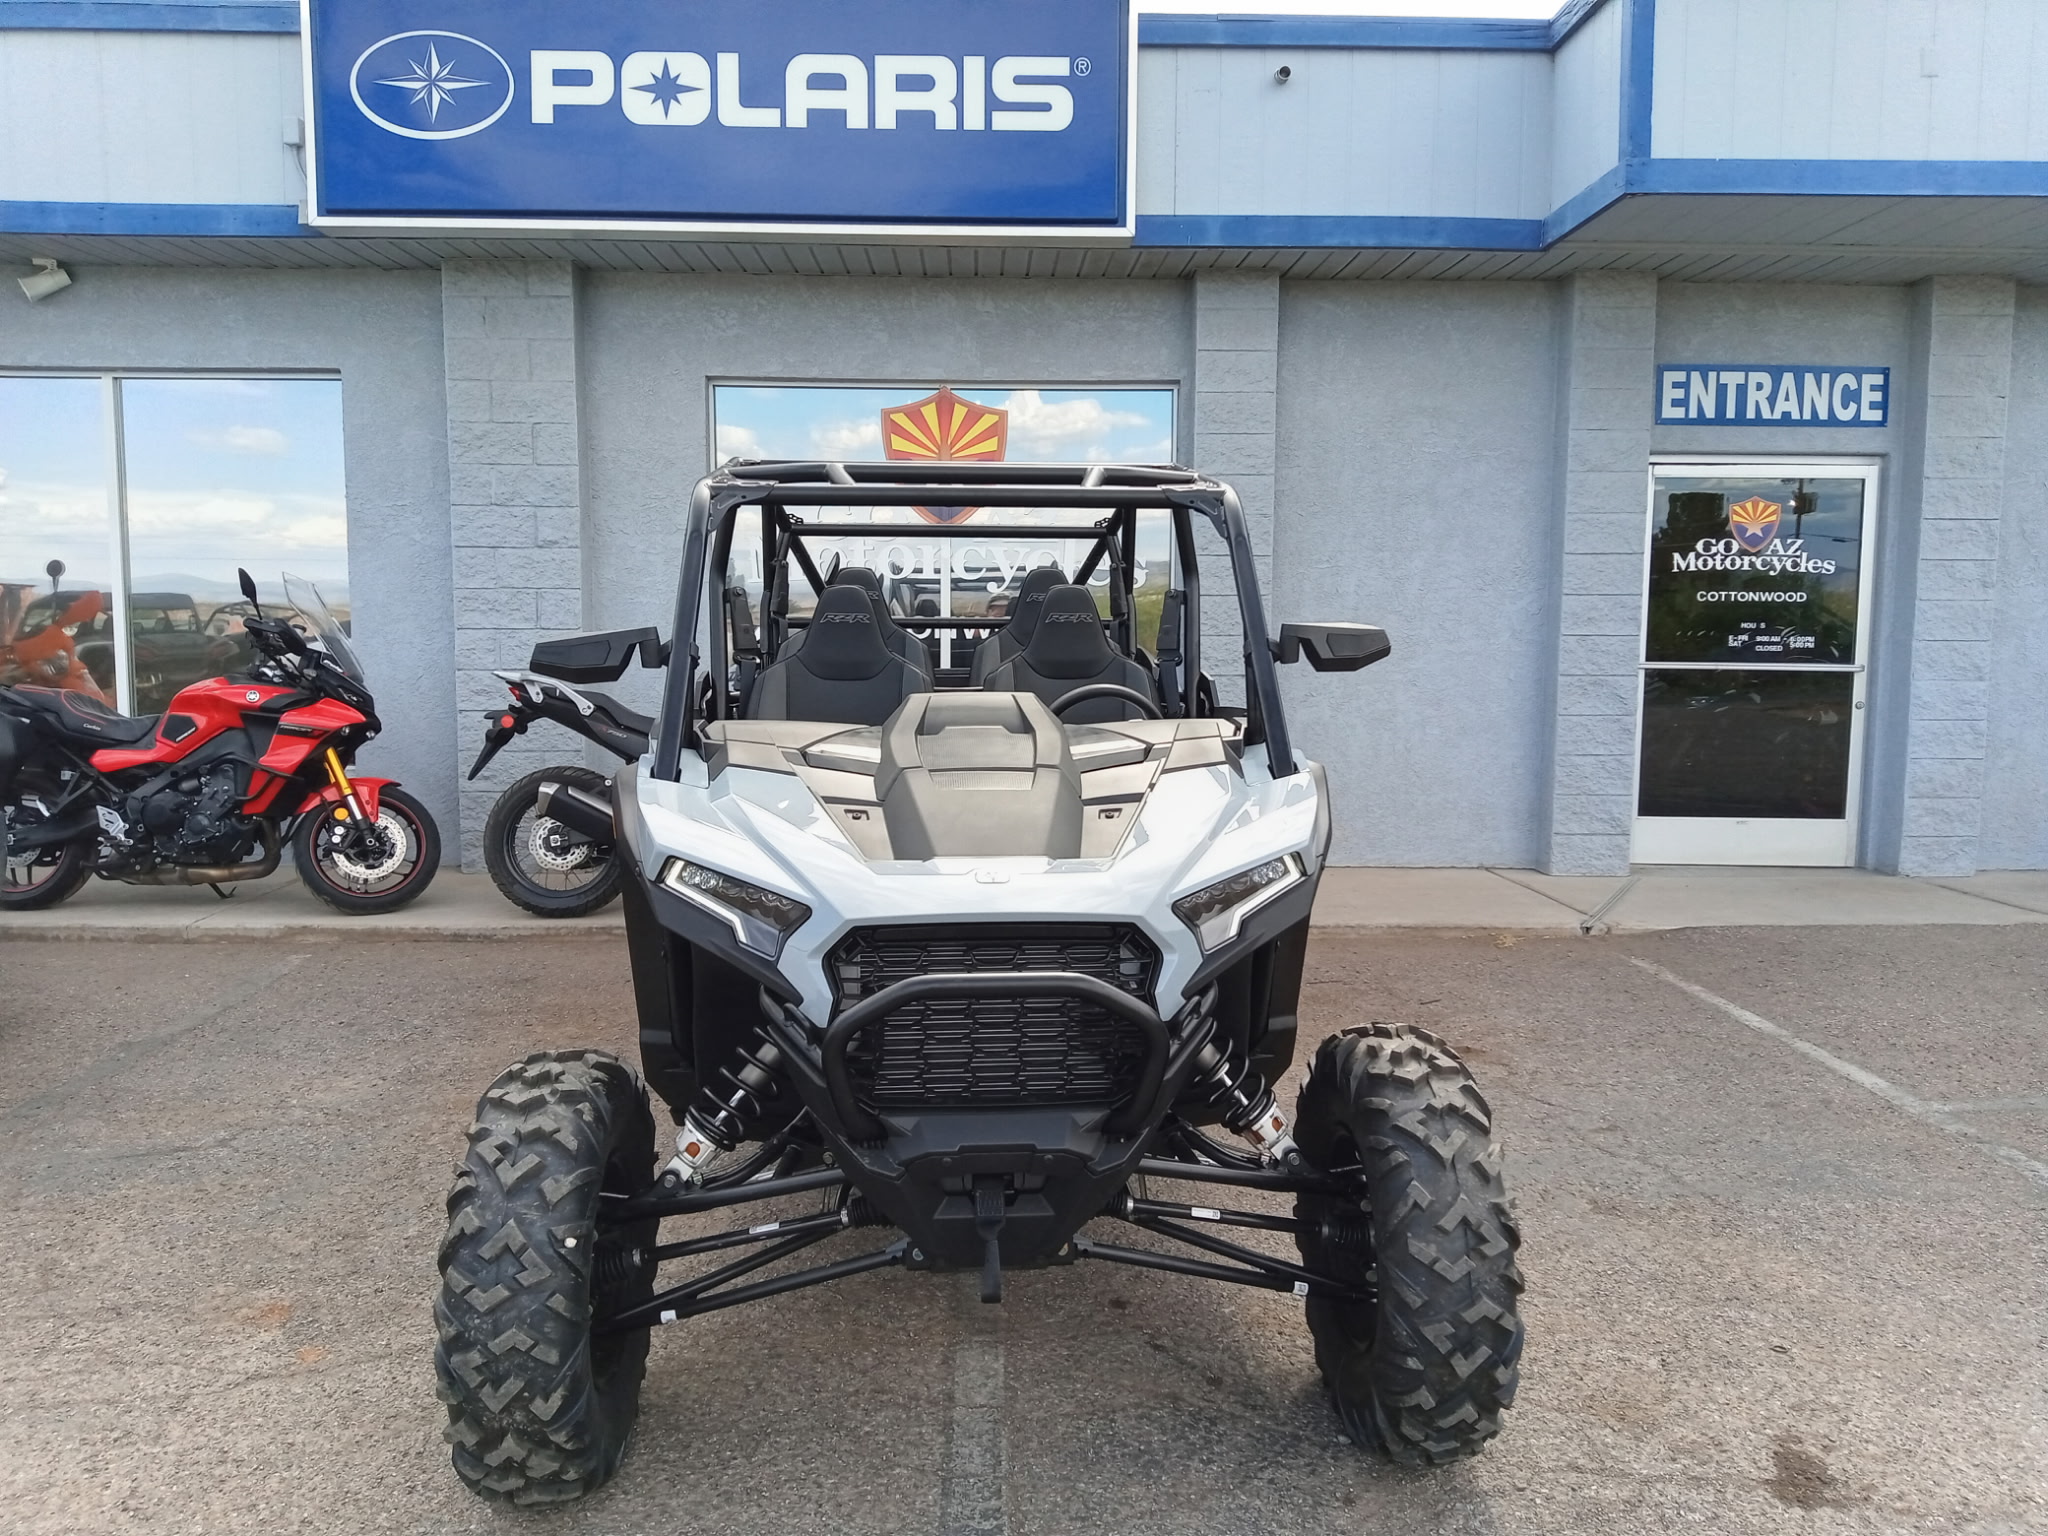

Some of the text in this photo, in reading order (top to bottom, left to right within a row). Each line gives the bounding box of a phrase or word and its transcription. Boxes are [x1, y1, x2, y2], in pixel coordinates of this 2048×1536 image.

[1661, 370, 1885, 422] ENTRANCE
[1694, 537, 1805, 556] GO AZ
[1671, 551, 1837, 576] Motorcycles
[1696, 590, 1808, 603] COTTONWOOD
[820, 612, 871, 624] RZR
[1045, 612, 1094, 624] RZR
